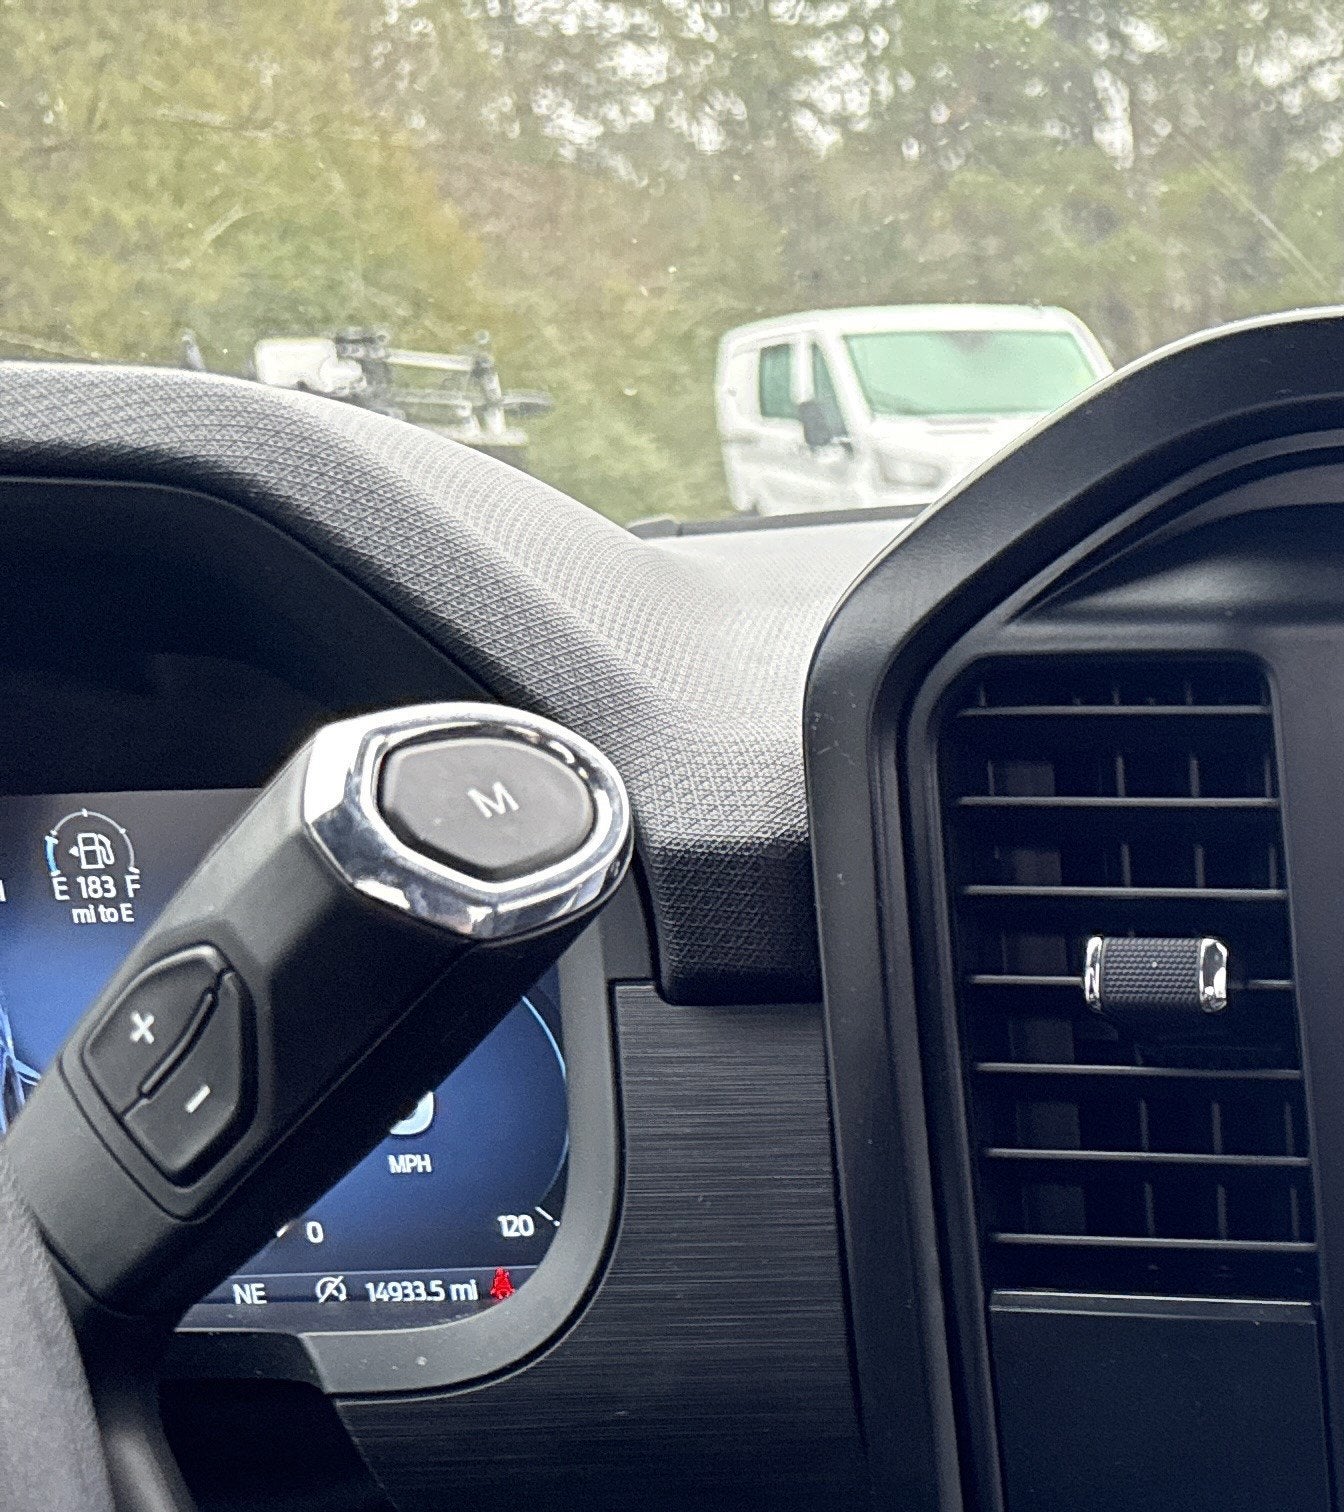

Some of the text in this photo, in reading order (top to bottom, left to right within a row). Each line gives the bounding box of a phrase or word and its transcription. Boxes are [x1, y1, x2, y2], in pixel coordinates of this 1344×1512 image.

[467, 782, 519, 818] M
[76, 875, 116, 898] 183
[72, 903, 134, 923] mi to E
[388, 1154, 431, 1173] MPH
[306, 1221, 323, 1243] 0
[497, 1215, 534, 1237] 120
[233, 1279, 478, 1304] NE 14933.5 mi
